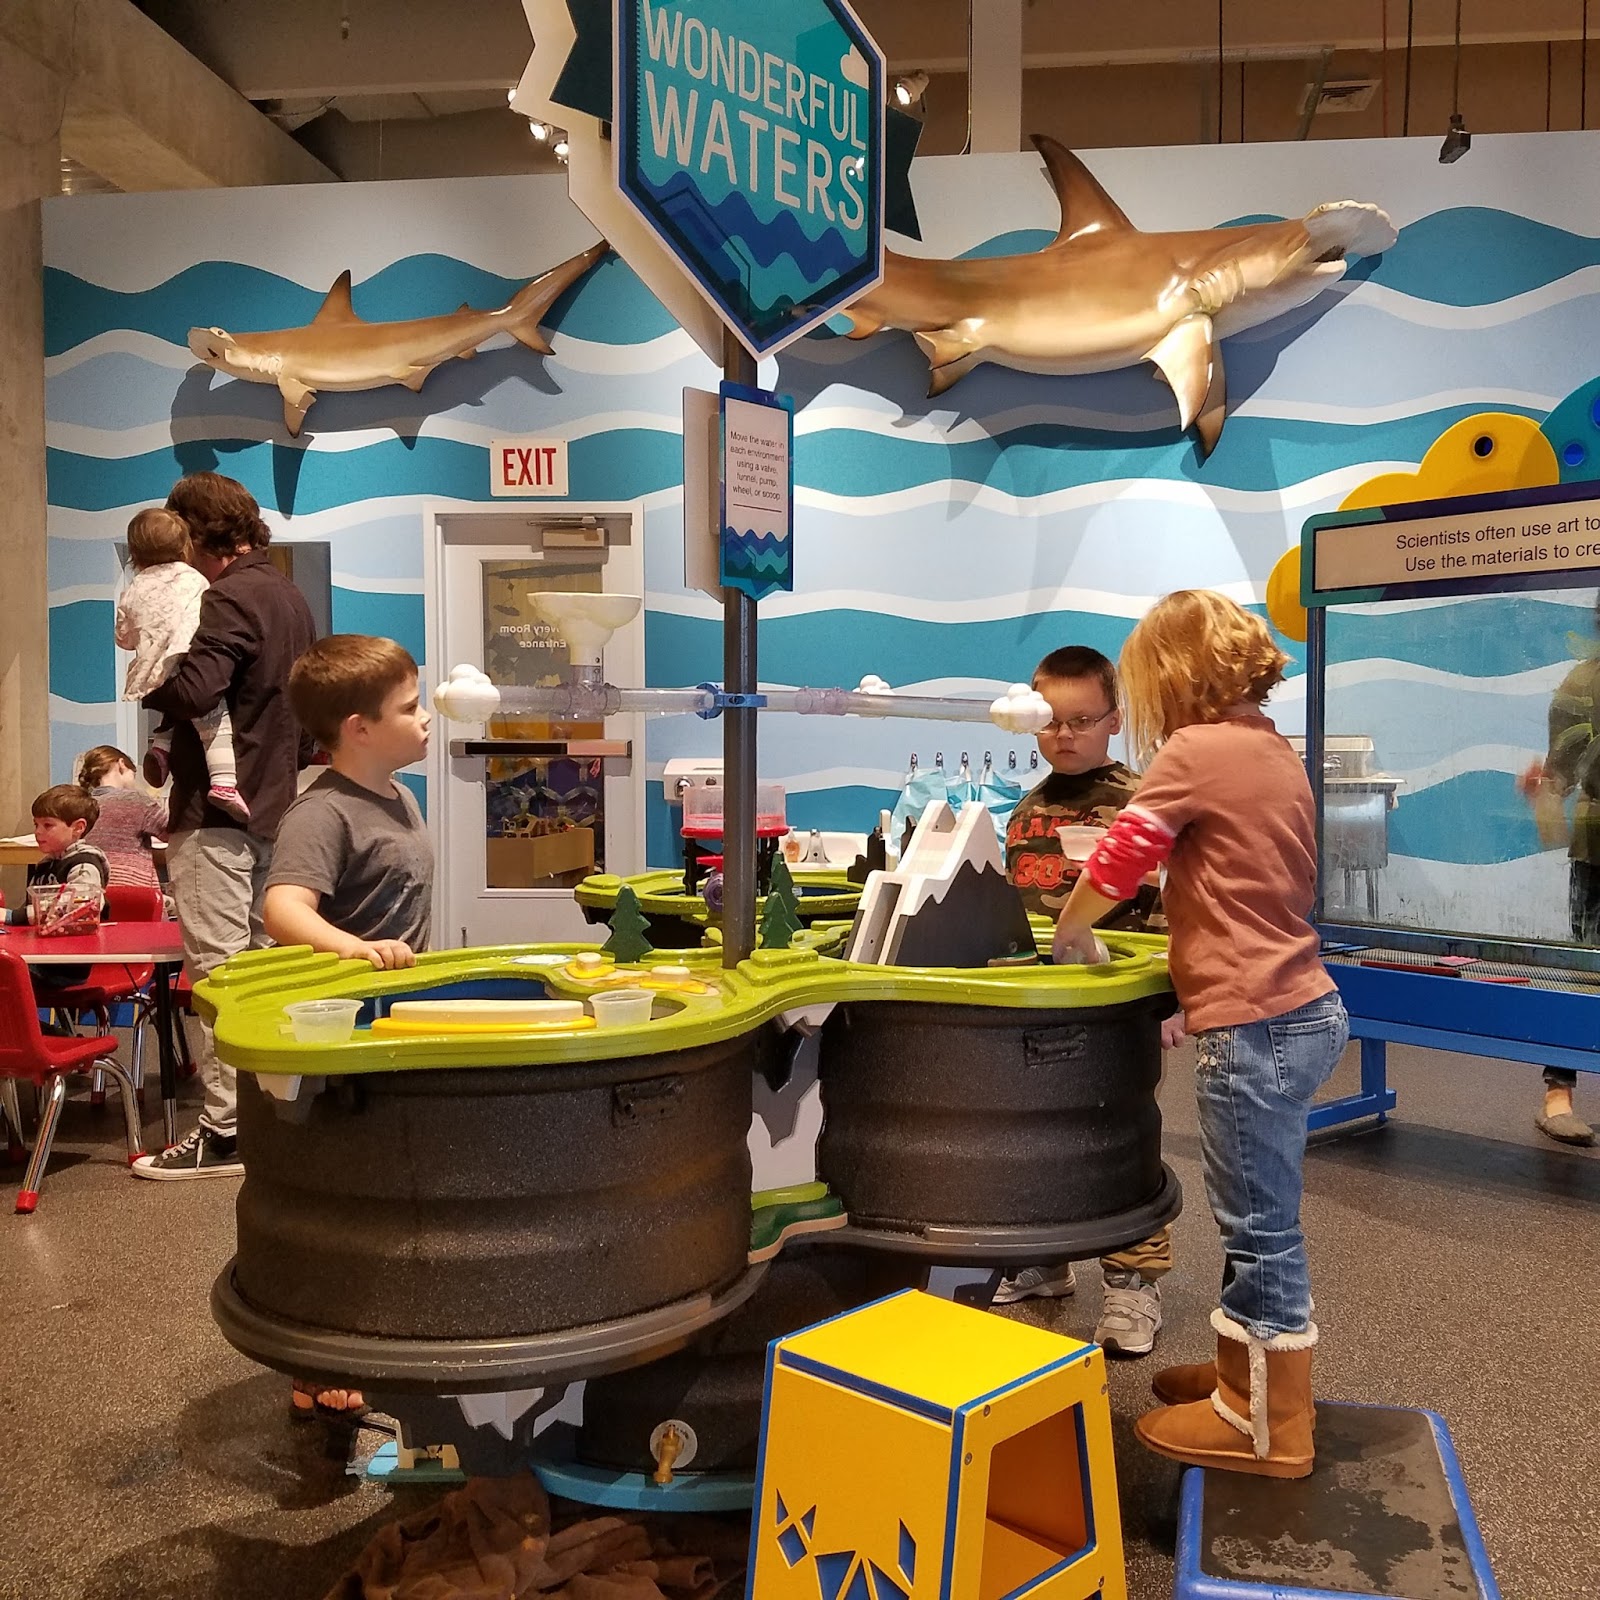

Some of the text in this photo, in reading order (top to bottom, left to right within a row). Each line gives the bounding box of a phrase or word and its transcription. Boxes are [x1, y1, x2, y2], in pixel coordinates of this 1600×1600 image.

[643, 0, 866, 150] WONDERFUL
[645, 70, 864, 230] WATERS
[730, 431, 748, 442] Move
[749, 435, 759, 445] the
[760, 438, 777, 448] water
[730, 445, 785, 462] each environment
[502, 447, 557, 486] EXIT
[736, 460, 754, 472] using
[1396, 515, 1600, 550] Scientists often use art to
[1405, 556, 1436, 572] Use
[1440, 553, 1467, 569] the
[1472, 545, 1548, 566] materials
[1553, 543, 1570, 559] to
